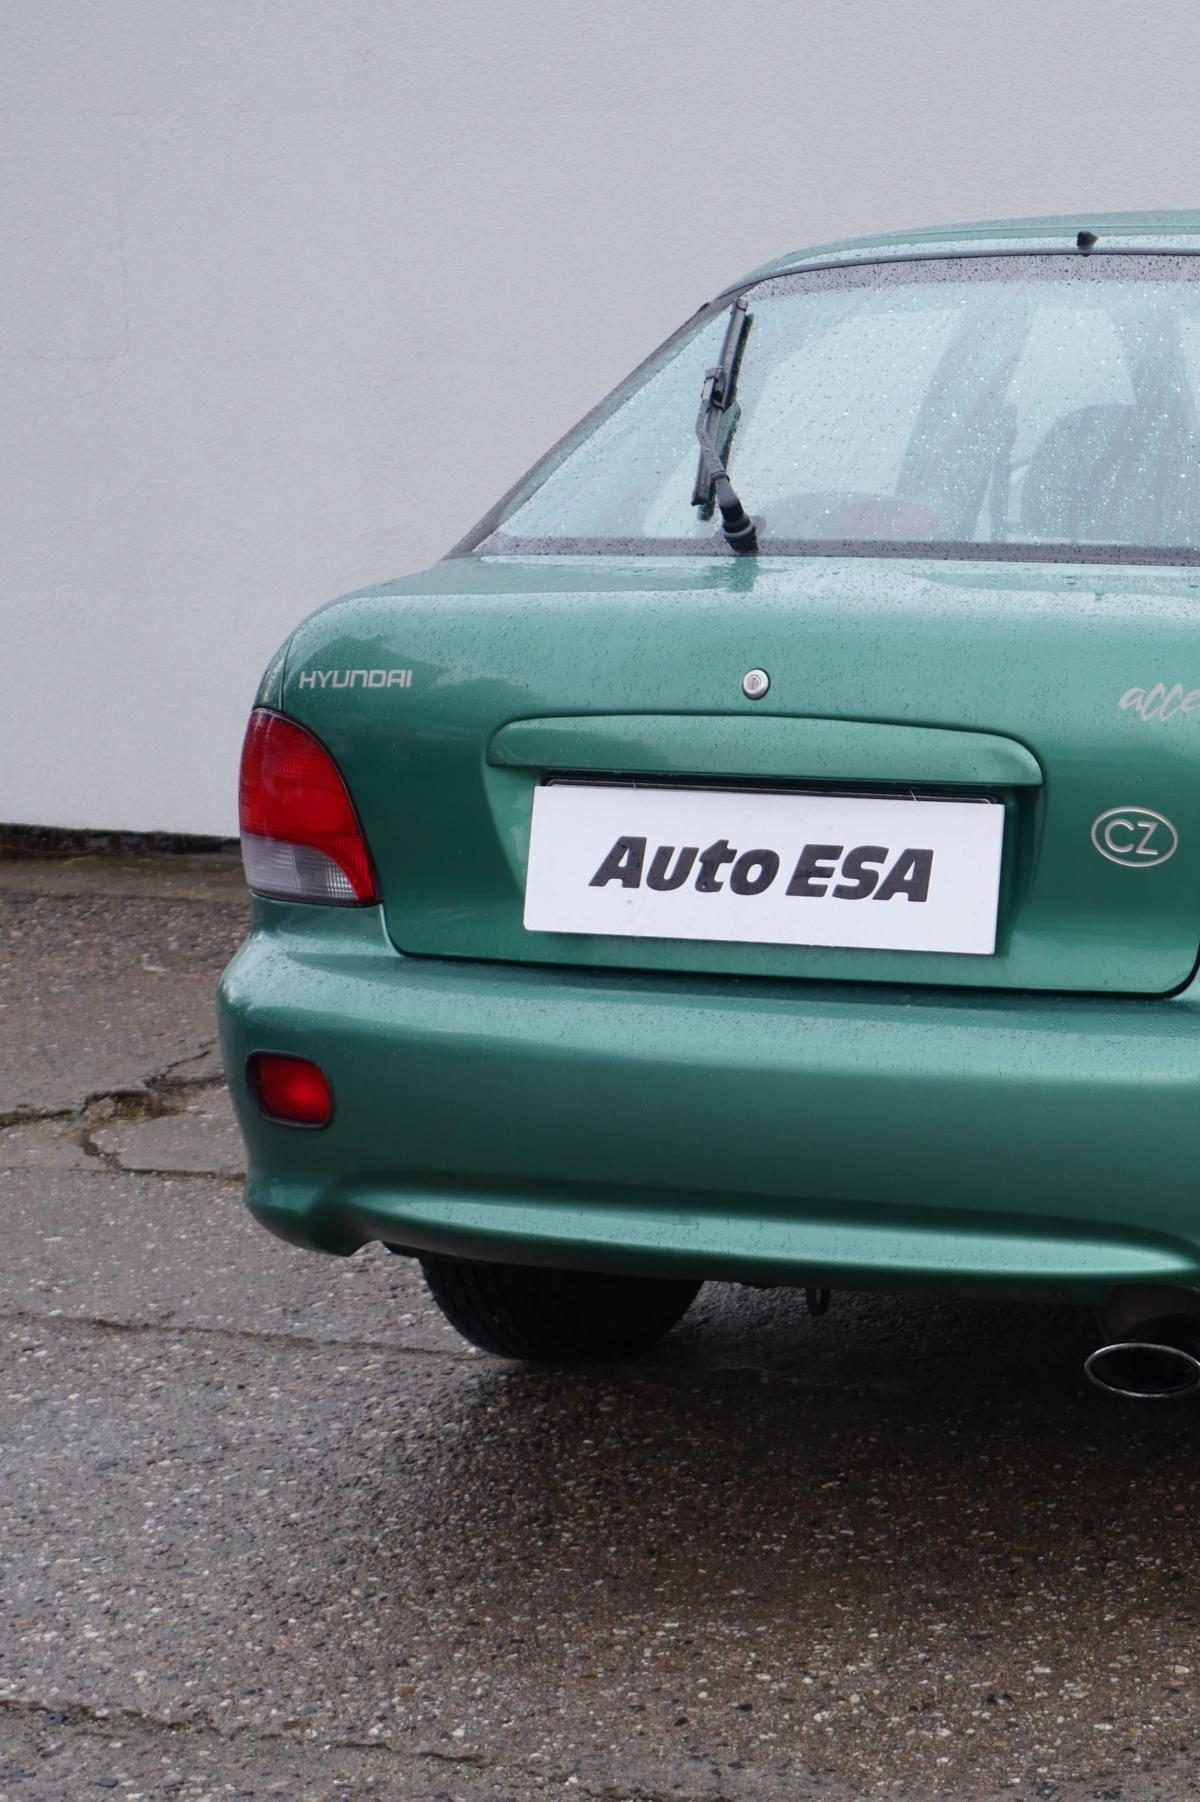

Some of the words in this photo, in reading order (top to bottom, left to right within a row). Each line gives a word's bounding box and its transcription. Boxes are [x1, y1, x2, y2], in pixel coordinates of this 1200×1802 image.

[299, 669, 413, 688] HYUNDAI
[1104, 818, 1158, 855] CZ
[588, 835, 780, 896] Auto
[784, 843, 934, 903] ESA
